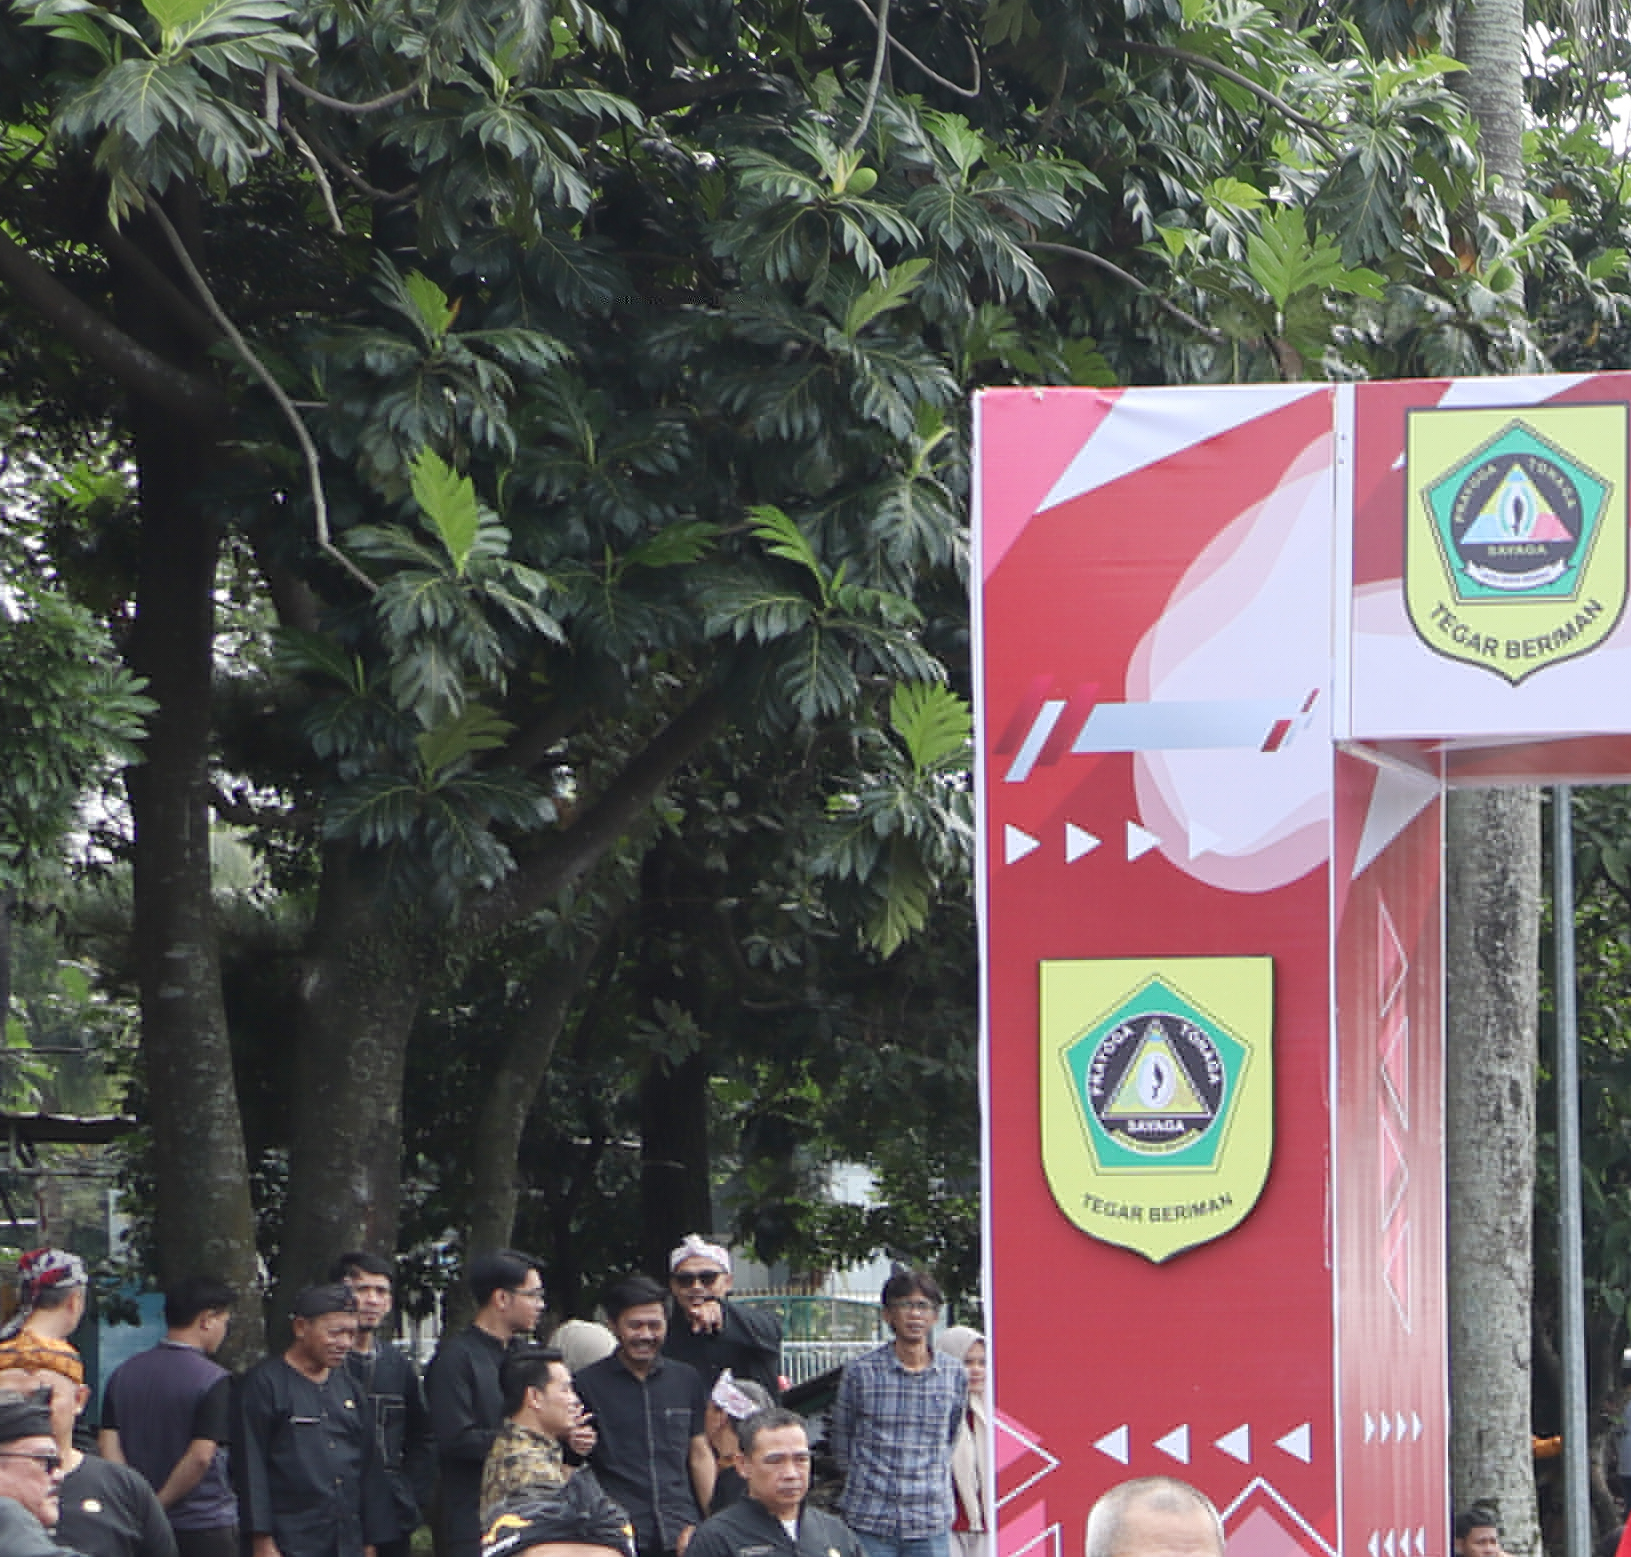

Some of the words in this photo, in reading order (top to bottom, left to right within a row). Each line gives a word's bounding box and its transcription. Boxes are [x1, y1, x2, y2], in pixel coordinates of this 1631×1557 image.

[1430, 600, 1499, 658] TEGAR
[1505, 599, 1604, 659] BERIMAN
[1082, 1191, 1144, 1222] TEGAR
[1149, 1191, 1234, 1222] BERIMAN
